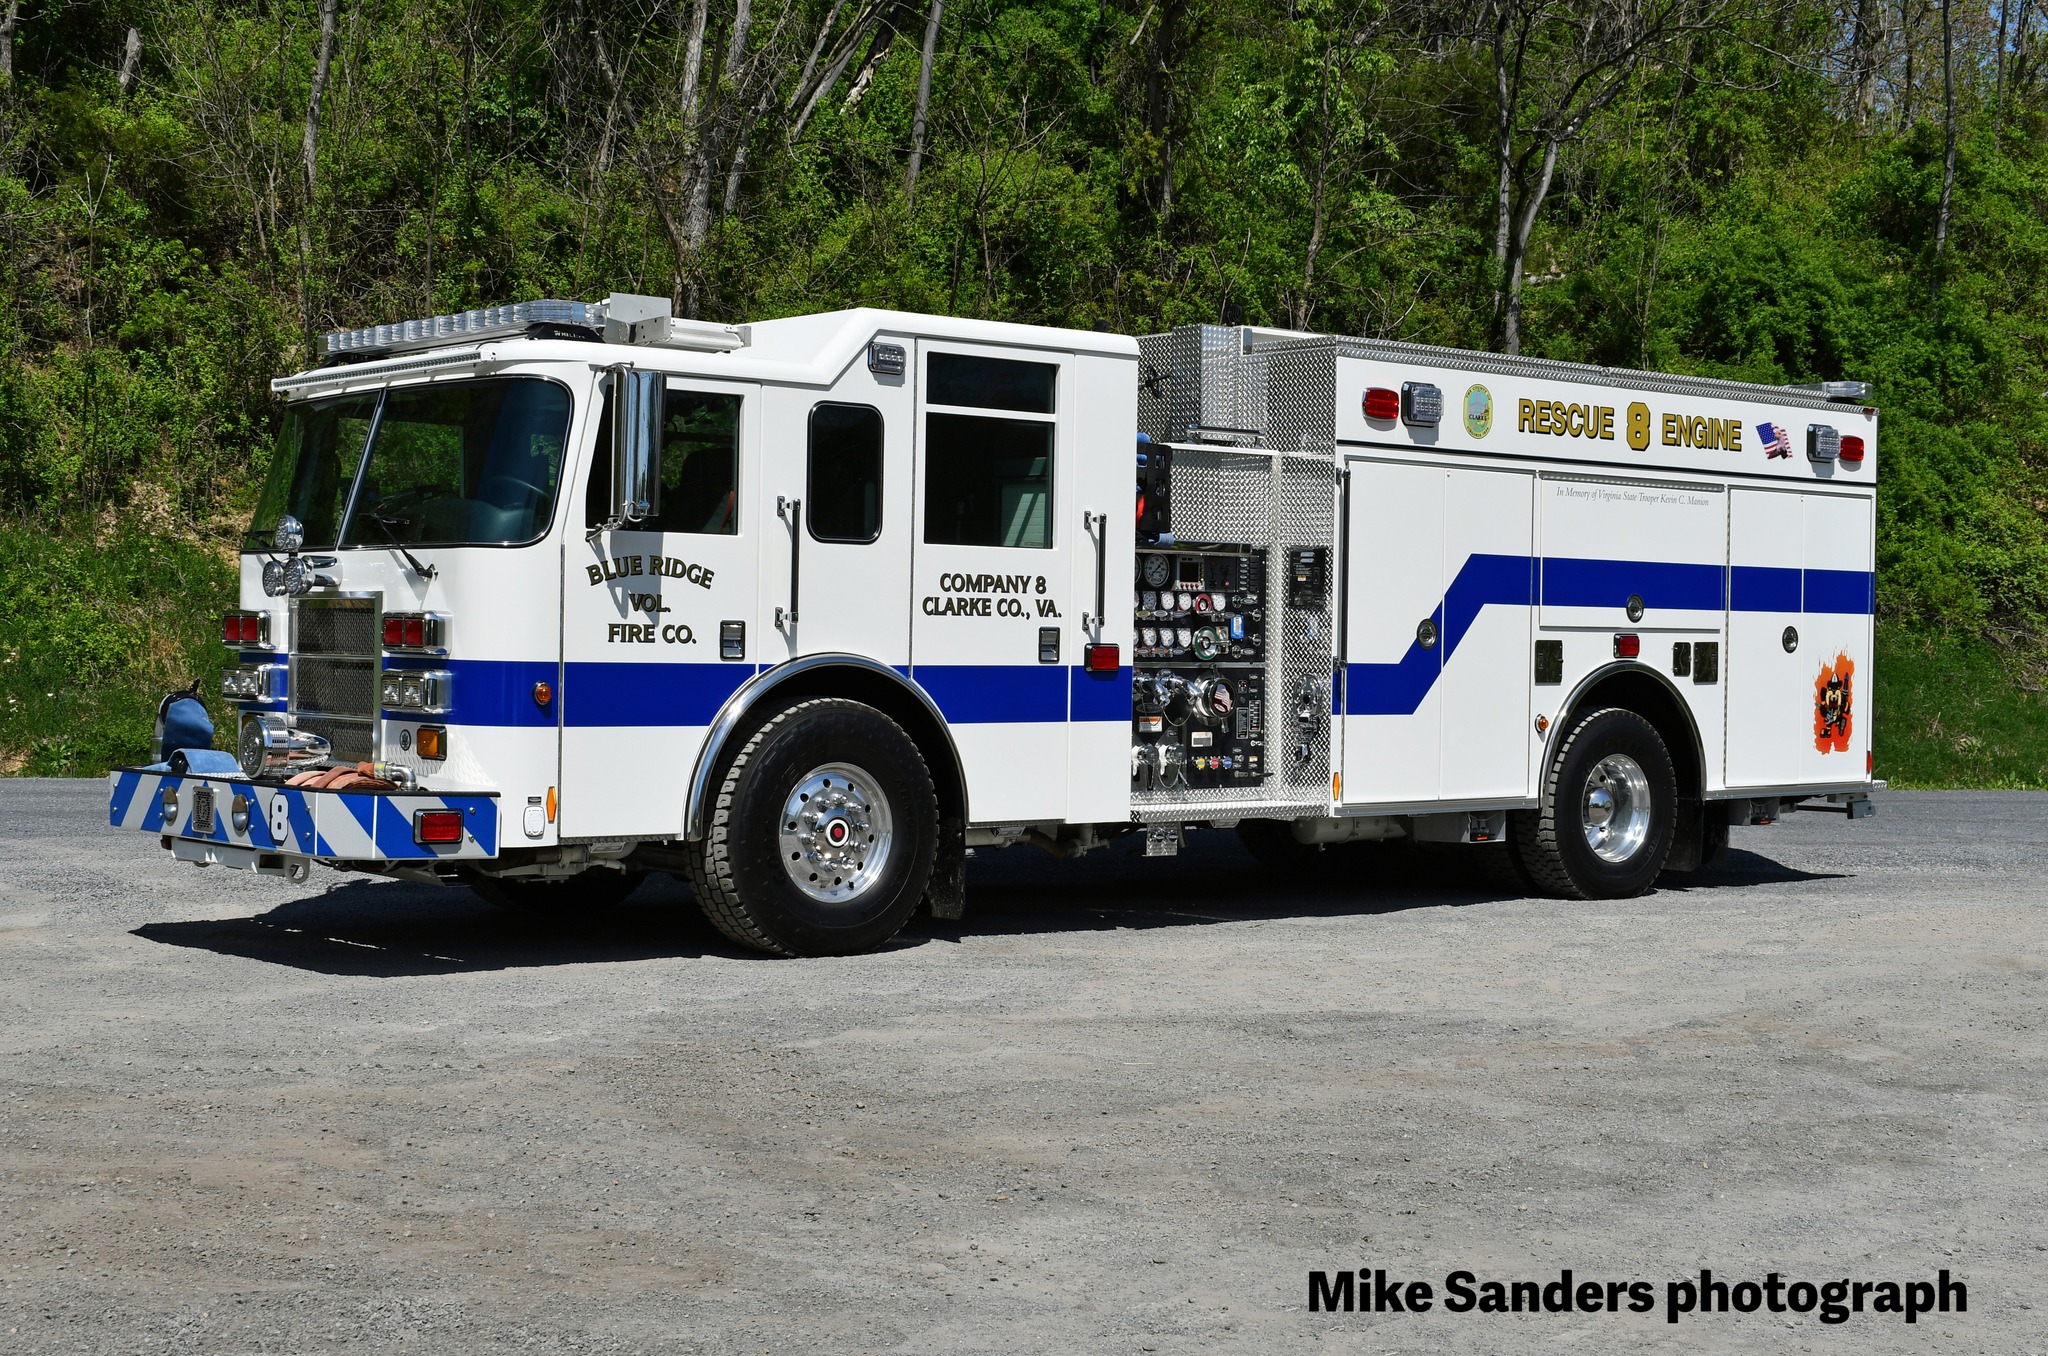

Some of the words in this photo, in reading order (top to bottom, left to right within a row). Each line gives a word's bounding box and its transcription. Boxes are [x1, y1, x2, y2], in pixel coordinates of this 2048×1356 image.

[1518, 398, 1615, 441] RESCUE
[1626, 401, 1651, 452] 8
[1661, 413, 1743, 452] ENGINE
[1556, 486, 1564, 496] In
[1565, 487, 1591, 501] Memory
[1591, 489, 1599, 501] of
[1598, 489, 1622, 502] Virginia
[1623, 491, 1638, 501] State
[1639, 492, 1660, 505] Trooper
[1660, 493, 1678, 504] Kevin
[1678, 495, 1686, 505] C.
[585, 555, 643, 586] BLUE
[649, 555, 715, 590] RIDGE
[939, 572, 1032, 594] COMPANY
[1035, 575, 1047, 594] 8
[629, 593, 671, 613] VOL.
[922, 596, 992, 617] CLARKE
[996, 598, 1031, 620] CO.,
[1035, 599, 1062, 618] VA.
[607, 623, 656, 643] FIRE
[661, 624, 697, 645] CO.
[269, 792, 289, 846] 8
